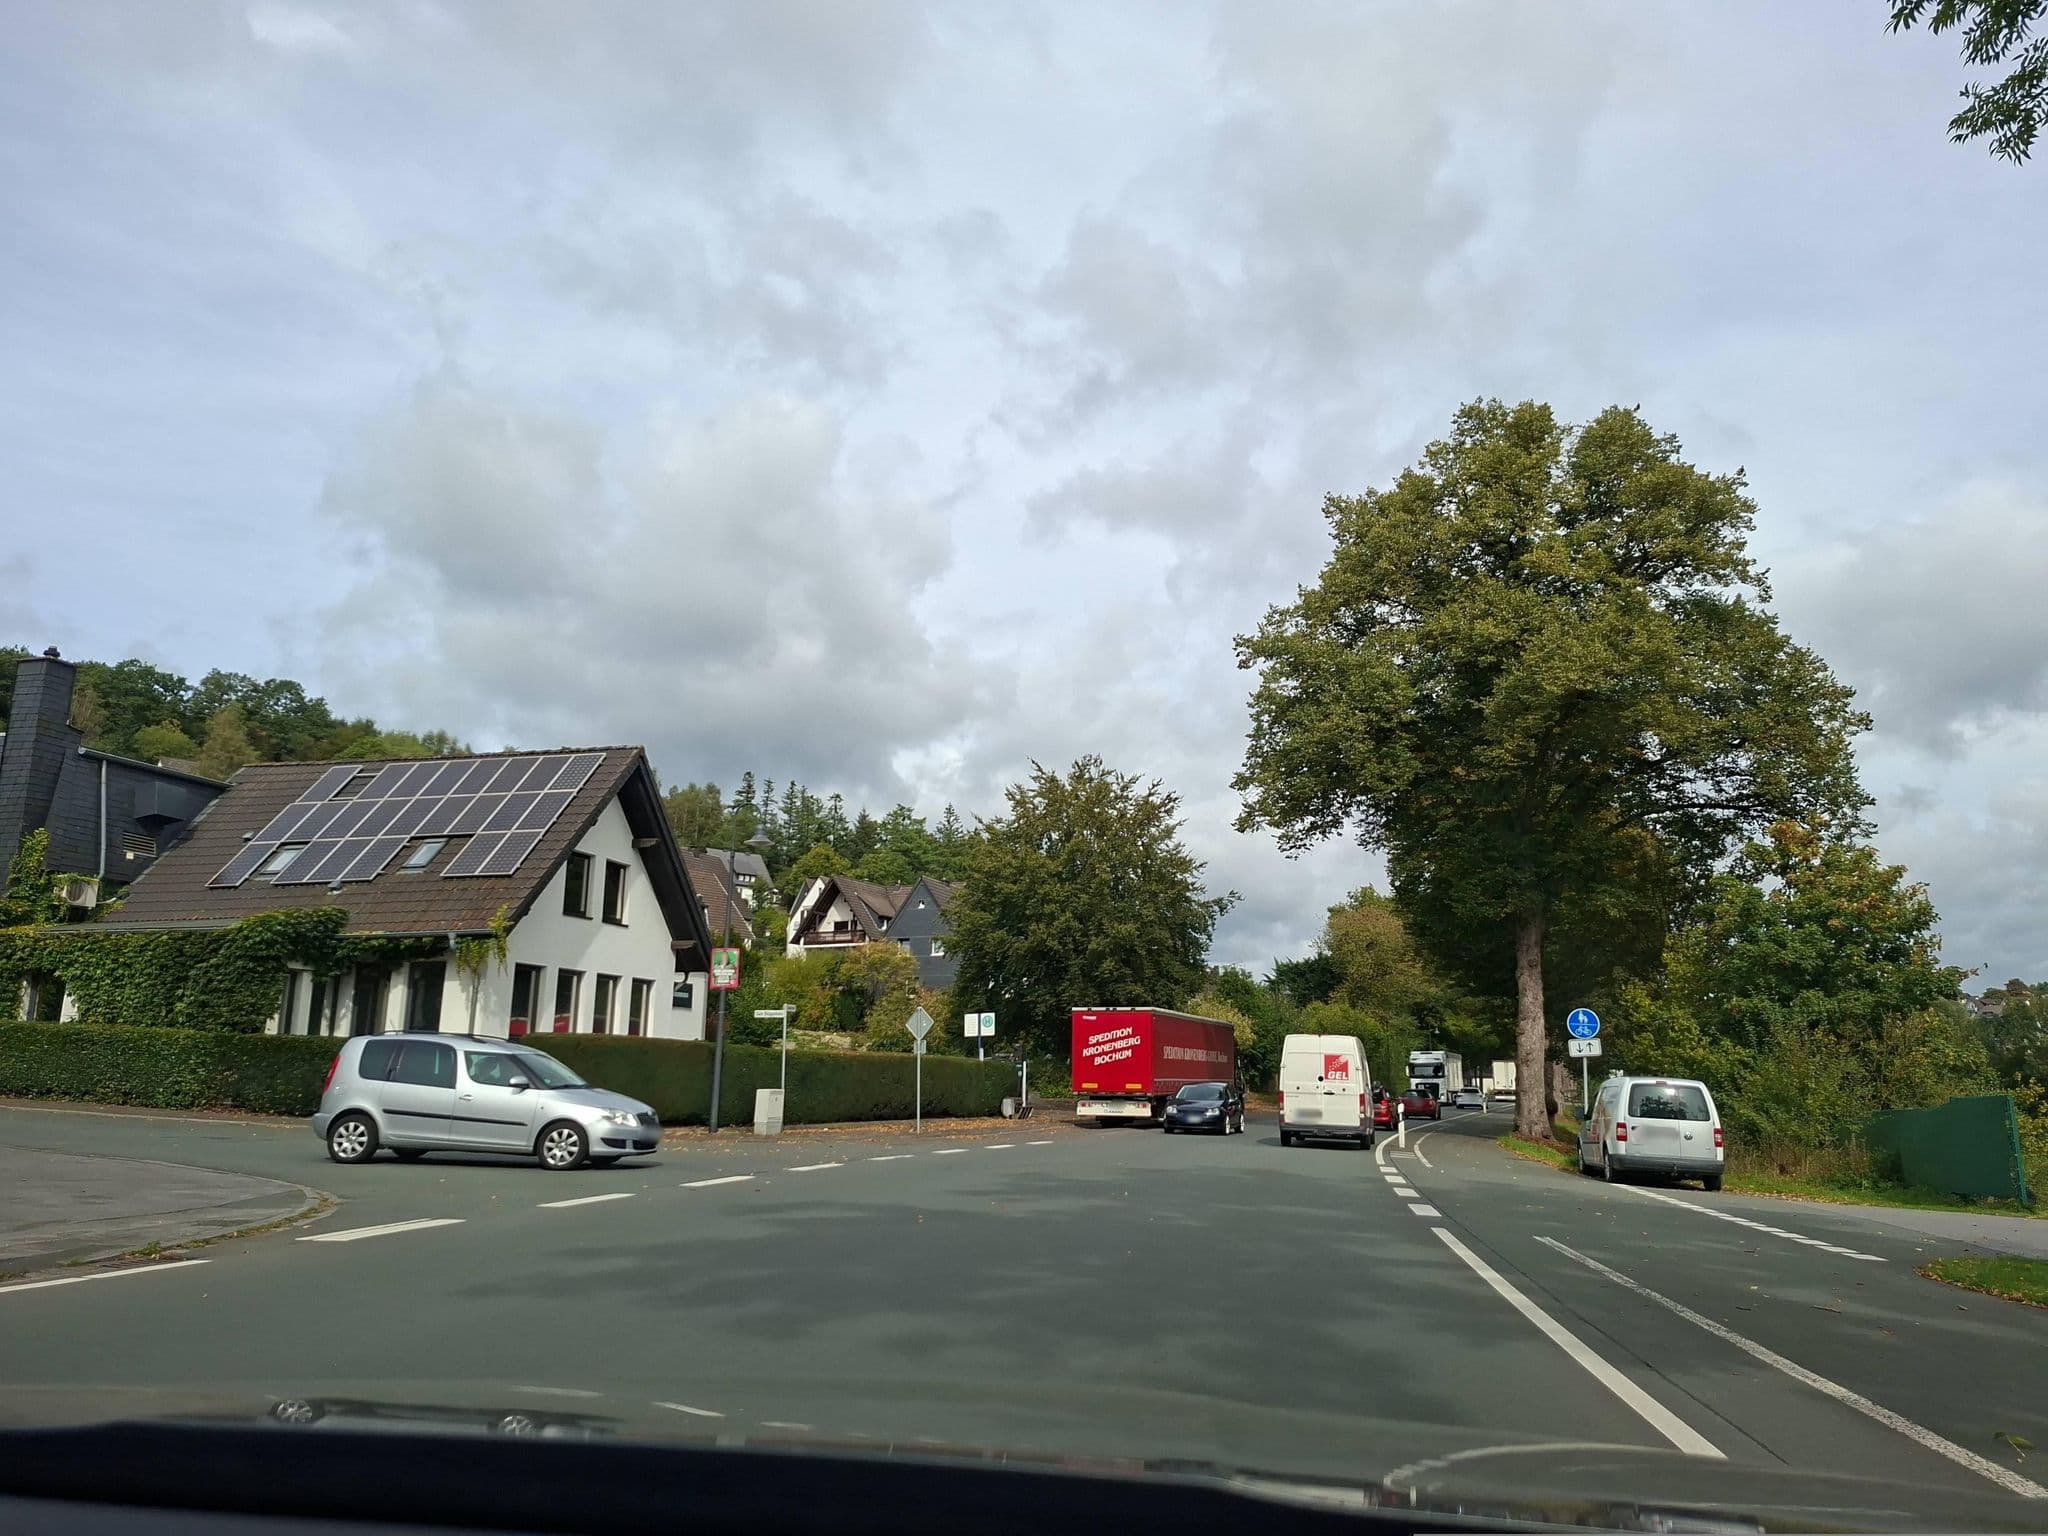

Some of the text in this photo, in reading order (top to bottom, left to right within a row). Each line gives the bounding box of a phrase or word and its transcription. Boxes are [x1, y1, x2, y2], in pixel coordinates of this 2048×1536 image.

[1088, 1027, 1133, 1044] SPEDITION
[1083, 1036, 1141, 1057] KRONENBERG
[1094, 1049, 1132, 1066] BOCHUM
